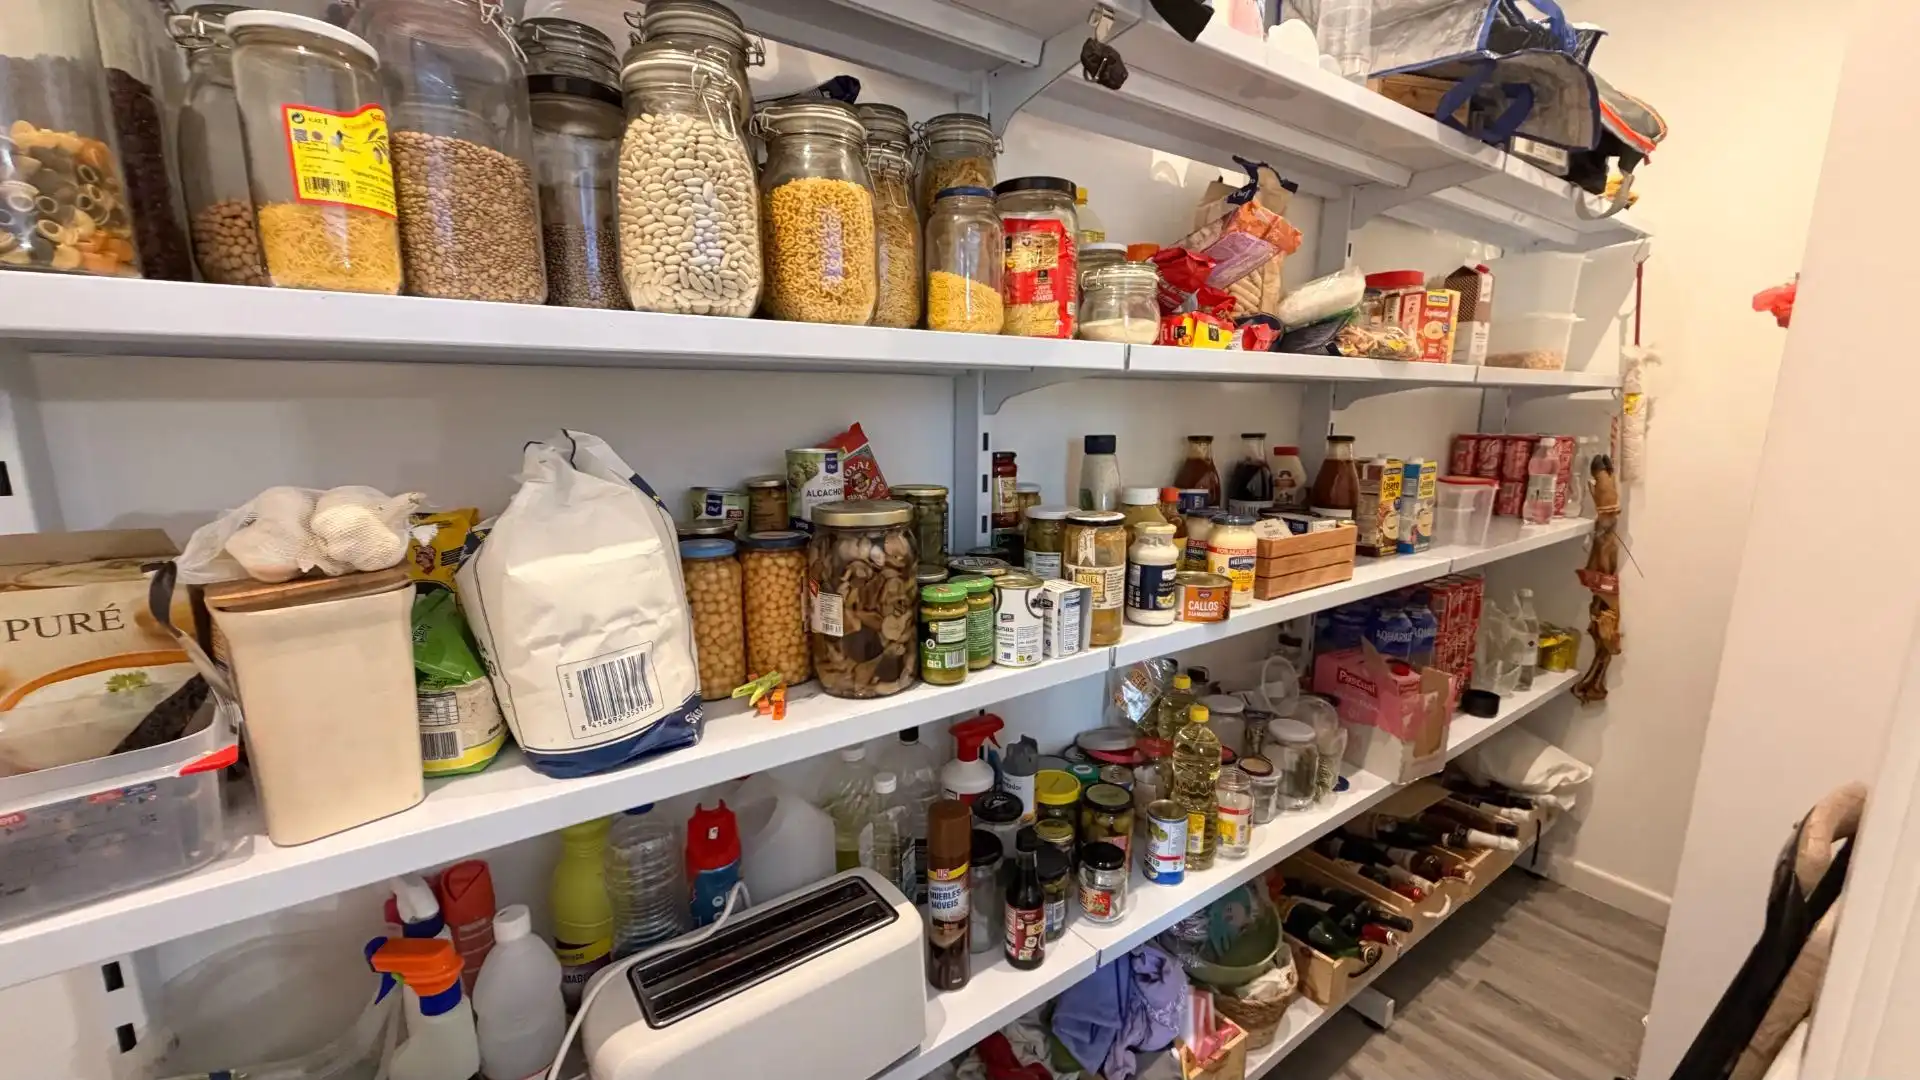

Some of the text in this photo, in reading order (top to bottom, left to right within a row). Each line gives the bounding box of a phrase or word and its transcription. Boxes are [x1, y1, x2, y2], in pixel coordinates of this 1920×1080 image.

[1188, 600, 1219, 611] CALLOS
[4, 602, 125, 642] PURÉ
[930, 888, 961, 901] MUEBLES
